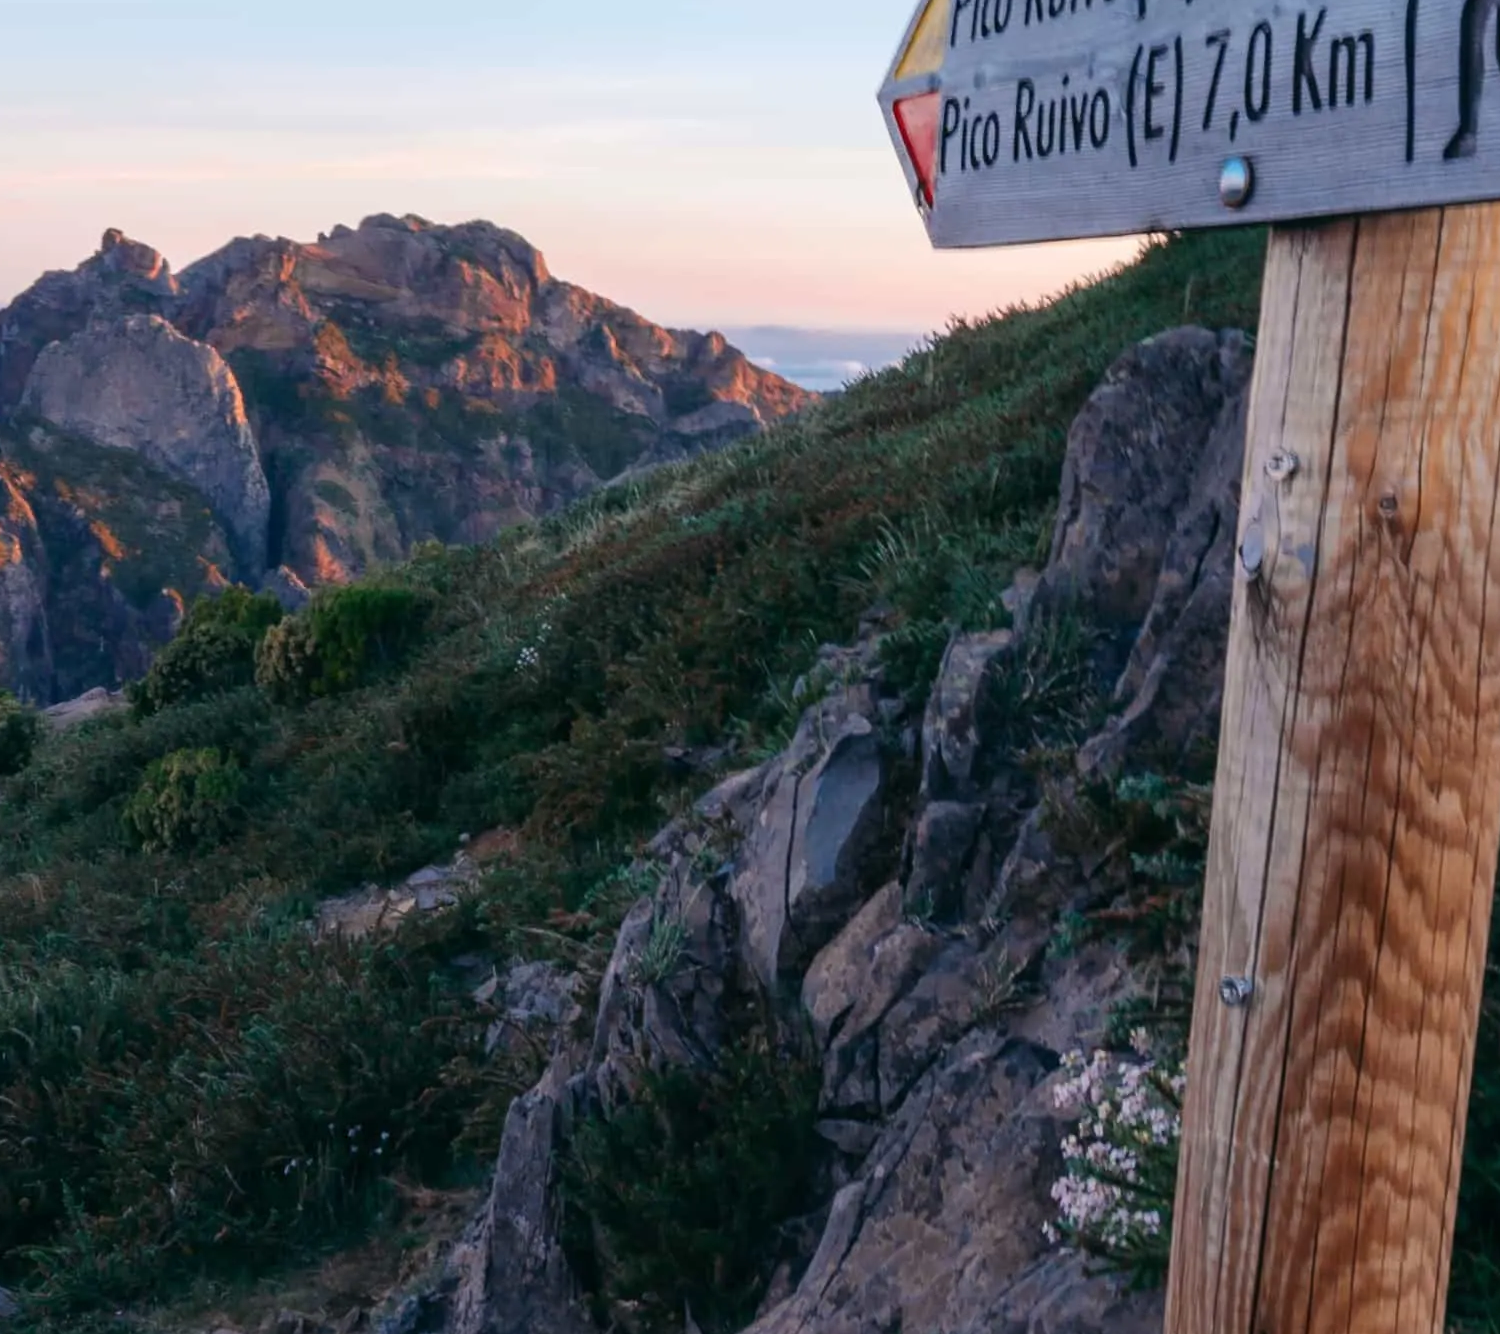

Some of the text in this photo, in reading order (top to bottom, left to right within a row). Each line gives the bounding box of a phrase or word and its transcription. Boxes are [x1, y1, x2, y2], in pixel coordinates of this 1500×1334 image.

[938, 6, 1374, 173] Pico Ruivo (E) 7,0 Km
